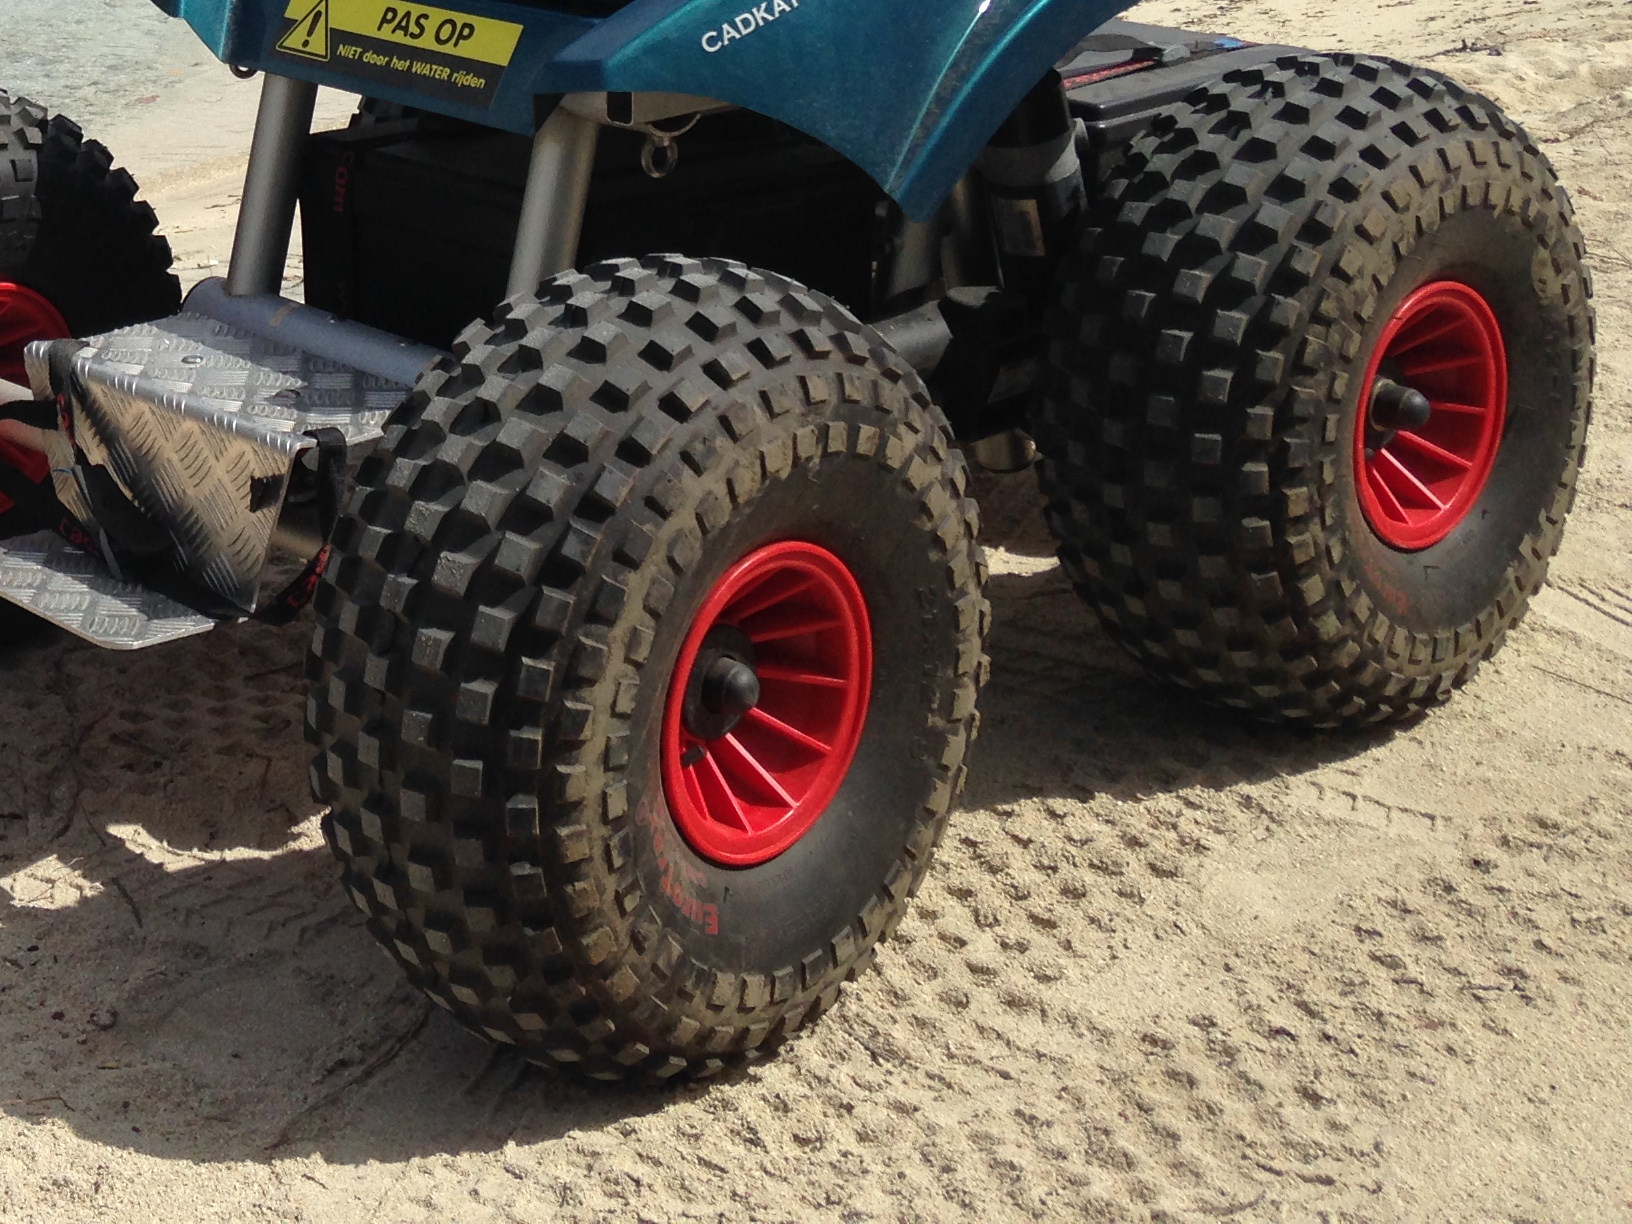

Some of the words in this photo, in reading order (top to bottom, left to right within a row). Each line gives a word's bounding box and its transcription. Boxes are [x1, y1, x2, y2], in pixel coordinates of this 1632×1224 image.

[377, 6, 429, 40] PAS
[434, 17, 475, 49] OP
[336, 43, 363, 60] NIET
[363, 49, 388, 69] door
[390, 55, 409, 72] het
[411, 60, 451, 81] WATER
[451, 70, 486, 89] rijden
